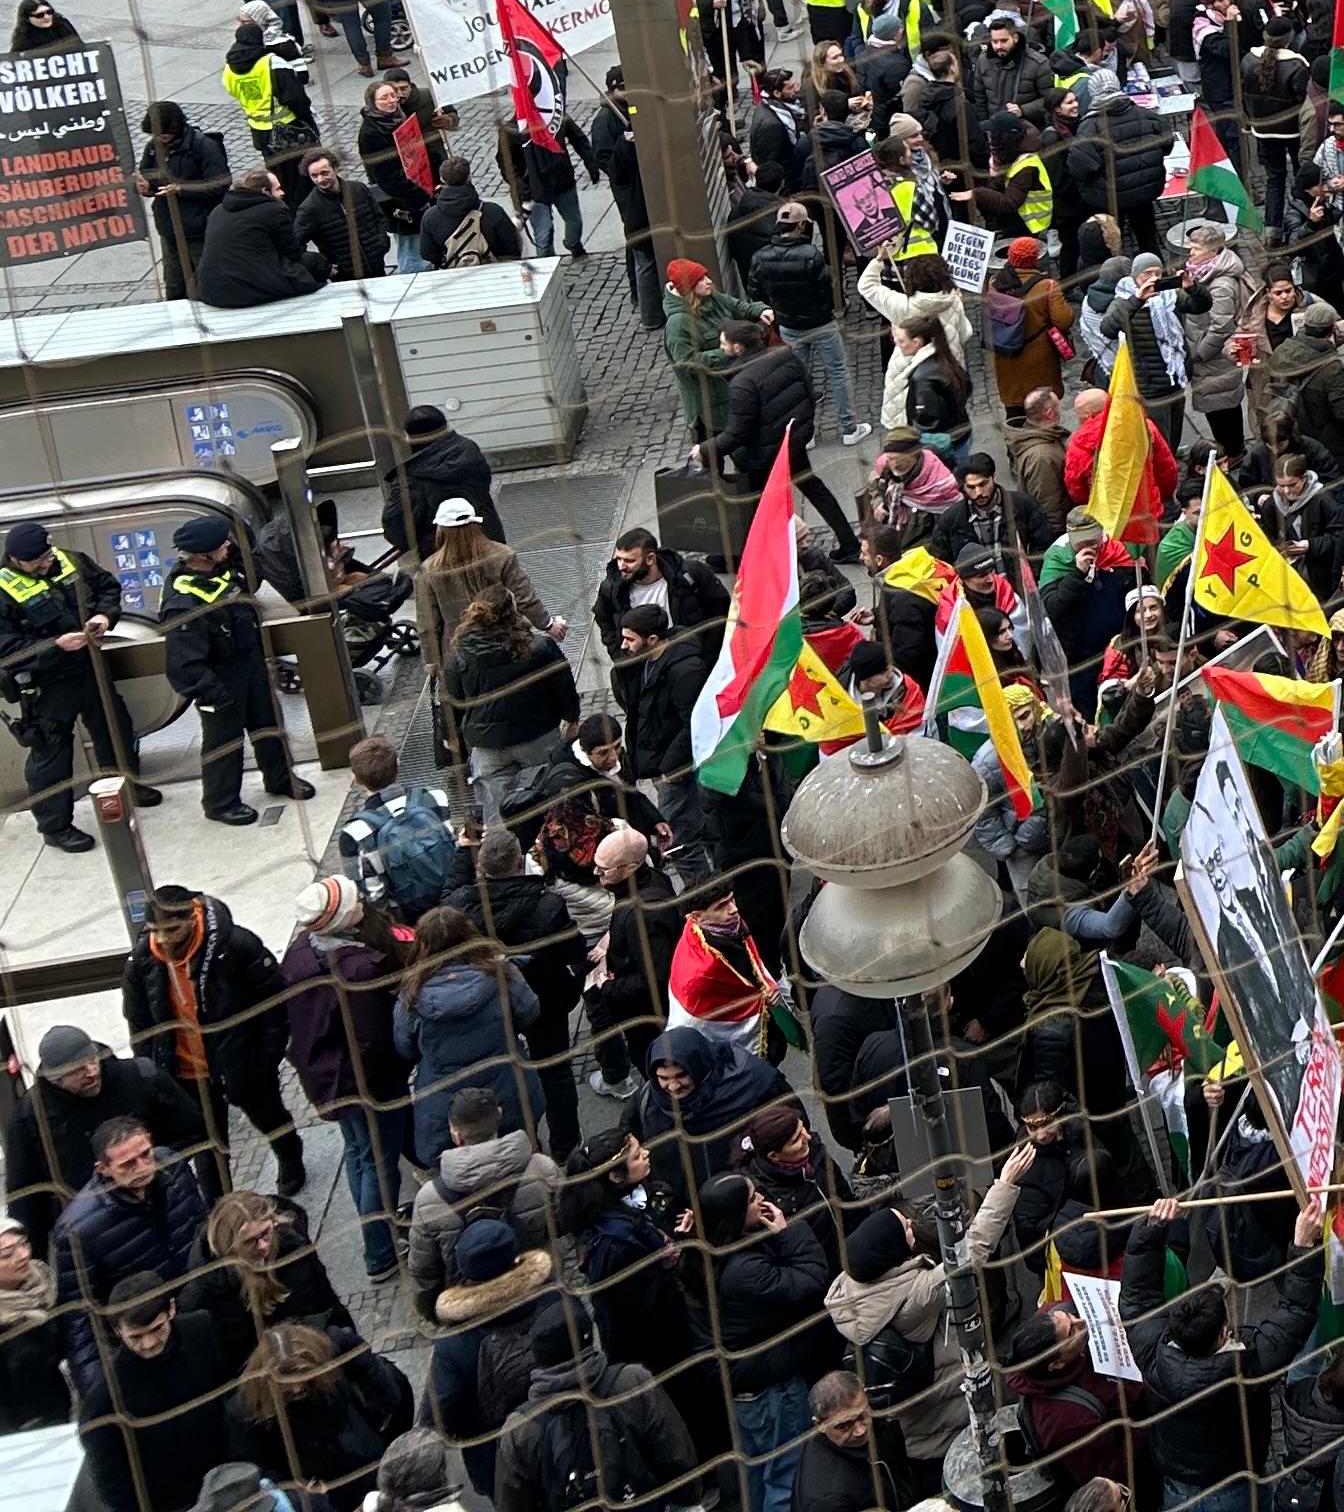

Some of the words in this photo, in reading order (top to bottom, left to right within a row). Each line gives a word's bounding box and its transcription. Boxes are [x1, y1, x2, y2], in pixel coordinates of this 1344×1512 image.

[0, 50, 100, 85] SRECHT
[0, 79, 108, 114] VÖLKER!
[1, 143, 121, 177] LANDRAUB.
[0, 165, 125, 204] SÄUBERUNG
[7, 230, 59, 259] DER
[61, 213, 136, 250] NATO!
[947, 240, 963, 254] DIE
[963, 244, 987, 261] NATO
[953, 232, 987, 250] GEGEN
[950, 265, 981, 283] AGUNG
